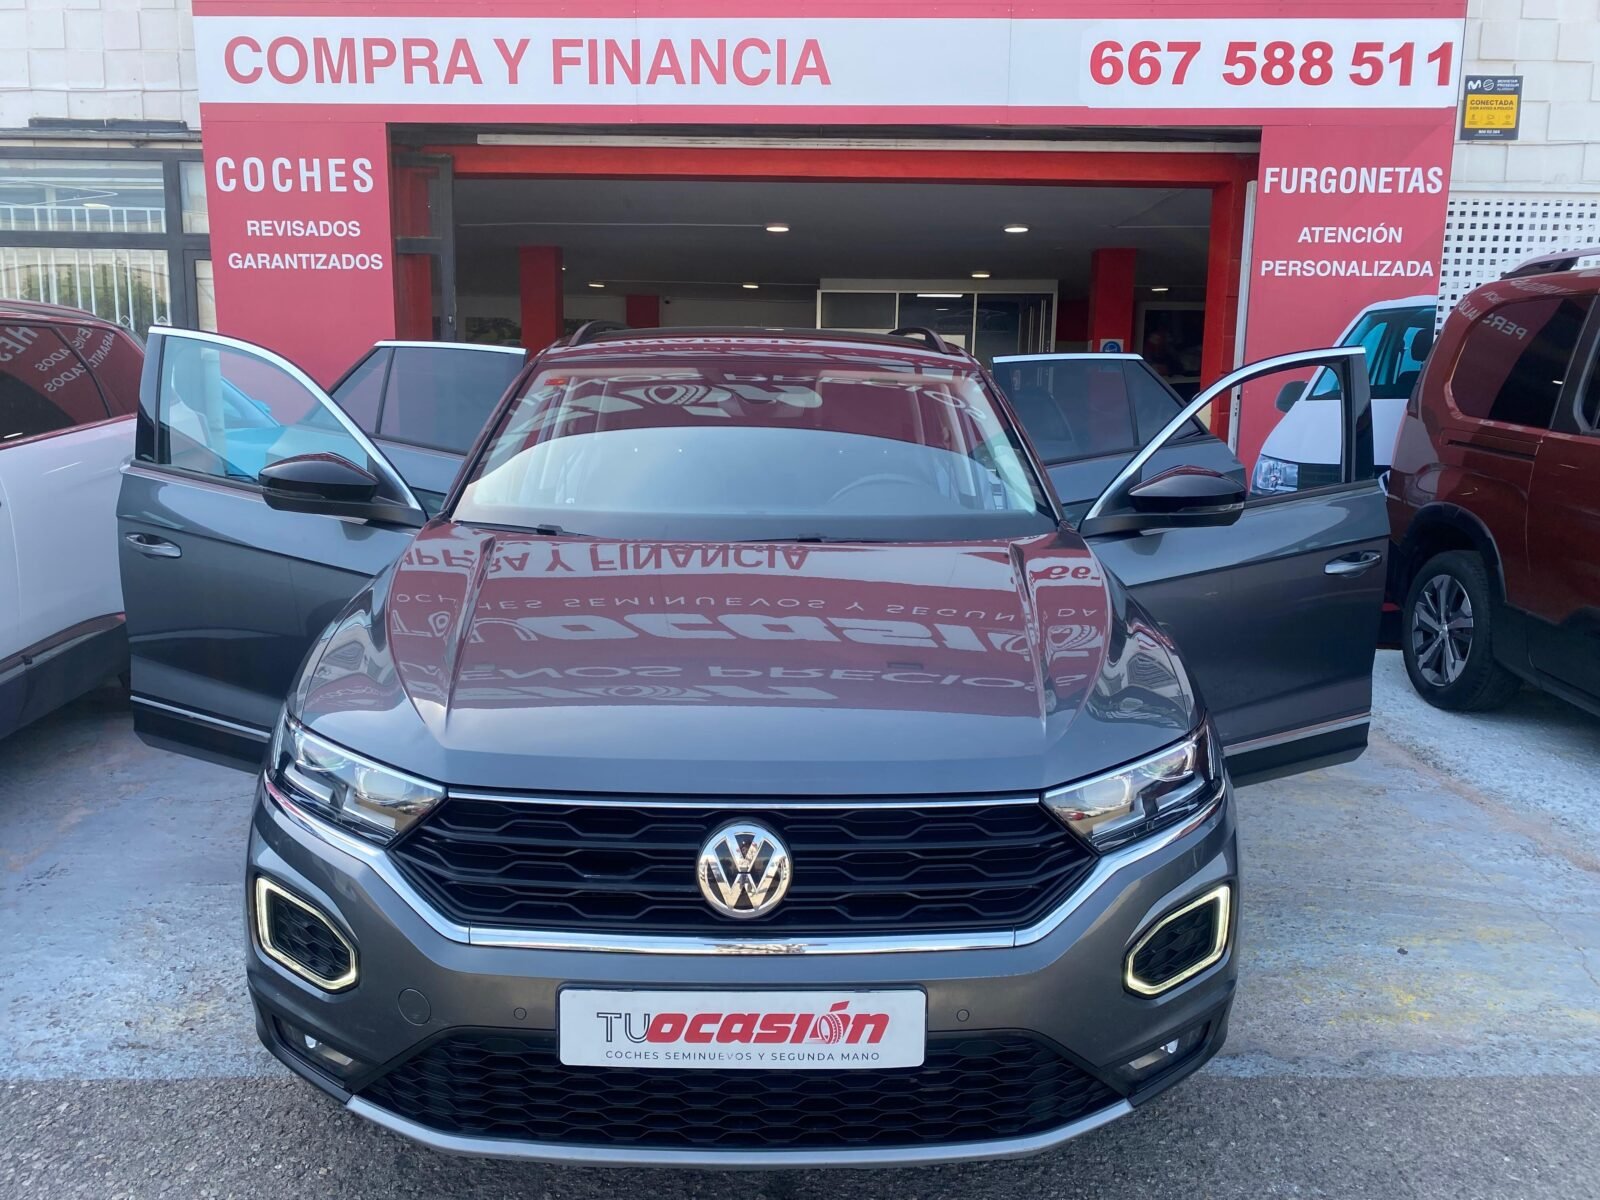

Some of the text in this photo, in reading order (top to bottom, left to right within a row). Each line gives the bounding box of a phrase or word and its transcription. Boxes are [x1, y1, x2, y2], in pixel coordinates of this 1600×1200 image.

[224, 35, 832, 86] COMPRA Y FINANCIA
[1089, 40, 1454, 87] 667 588 511
[215, 156, 374, 193] COCHES
[1264, 166, 1444, 195] FURGONETAS
[246, 220, 361, 237] REVISADOS
[1297, 222, 1403, 244] ATENCIÓN
[228, 252, 384, 270] GARANTIZADOS
[1260, 259, 1434, 278] PERSONALIZADA
[605, 1050, 880, 1062] COCHES SEMINUEVOS Y SEGUNDA MANO
